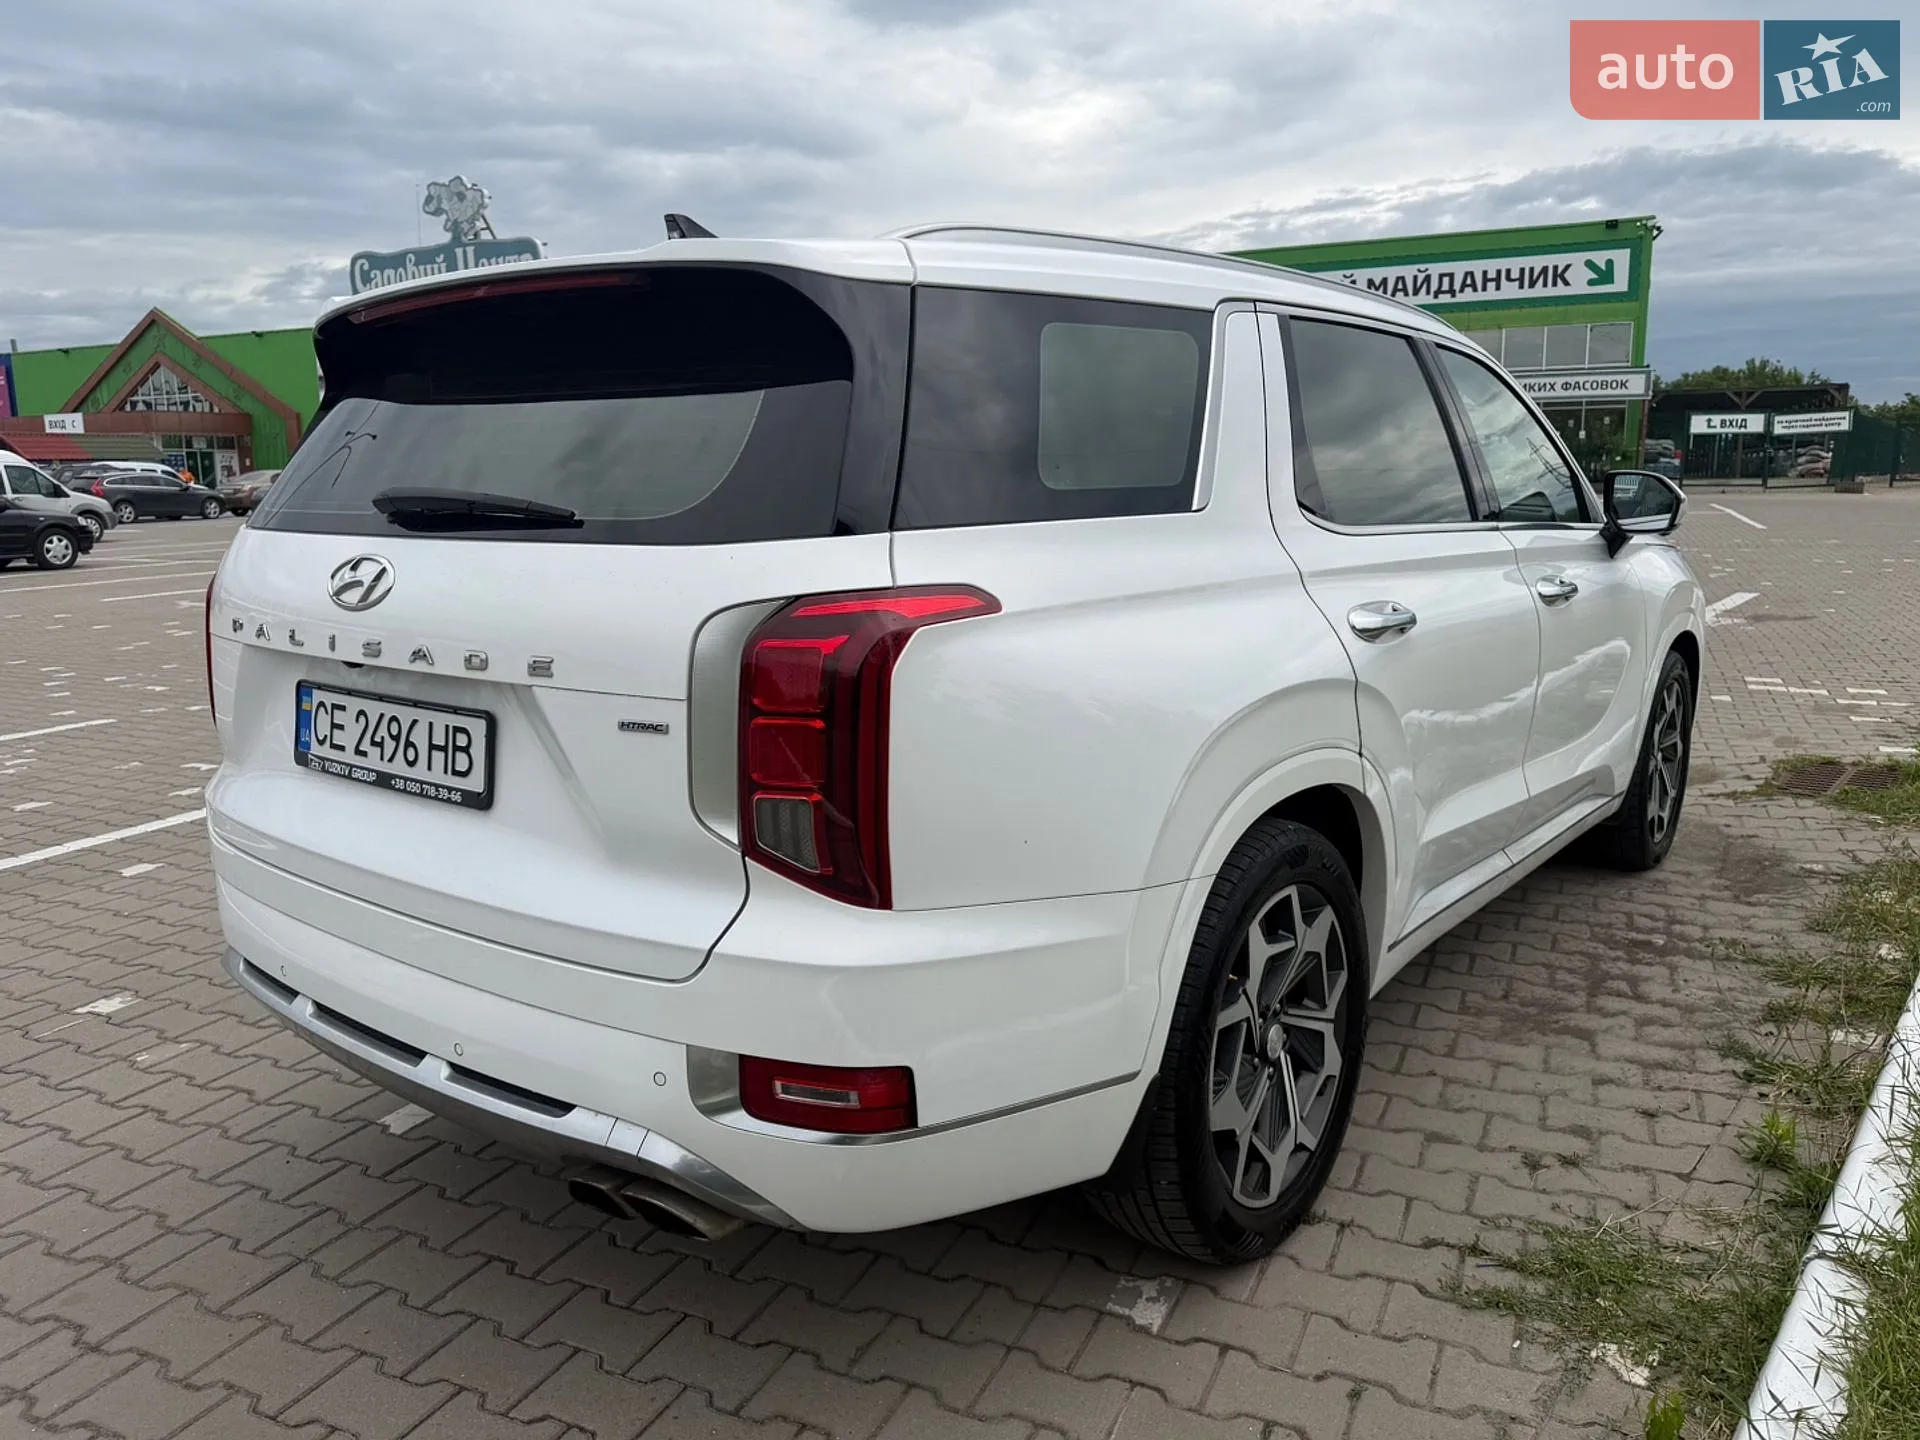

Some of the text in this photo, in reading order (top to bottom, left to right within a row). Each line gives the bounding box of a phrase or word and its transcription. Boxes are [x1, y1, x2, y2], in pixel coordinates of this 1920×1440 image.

[1366, 262, 1573, 299] МАЙДАНЧИК
[1560, 379, 1630, 392] ФАСОВОК
[48, 419, 67, 430] ВХІД
[1719, 417, 1748, 431] ВХІД
[231, 617, 554, 679] PALISADE
[620, 721, 665, 732] HTRAC
[313, 700, 474, 779] CE 2496 HB
[351, 766, 377, 783] GROUP
[390, 778, 405, 790] +38
[406, 780, 421, 793] 050
[422, 783, 463, 803] 718-39-66
